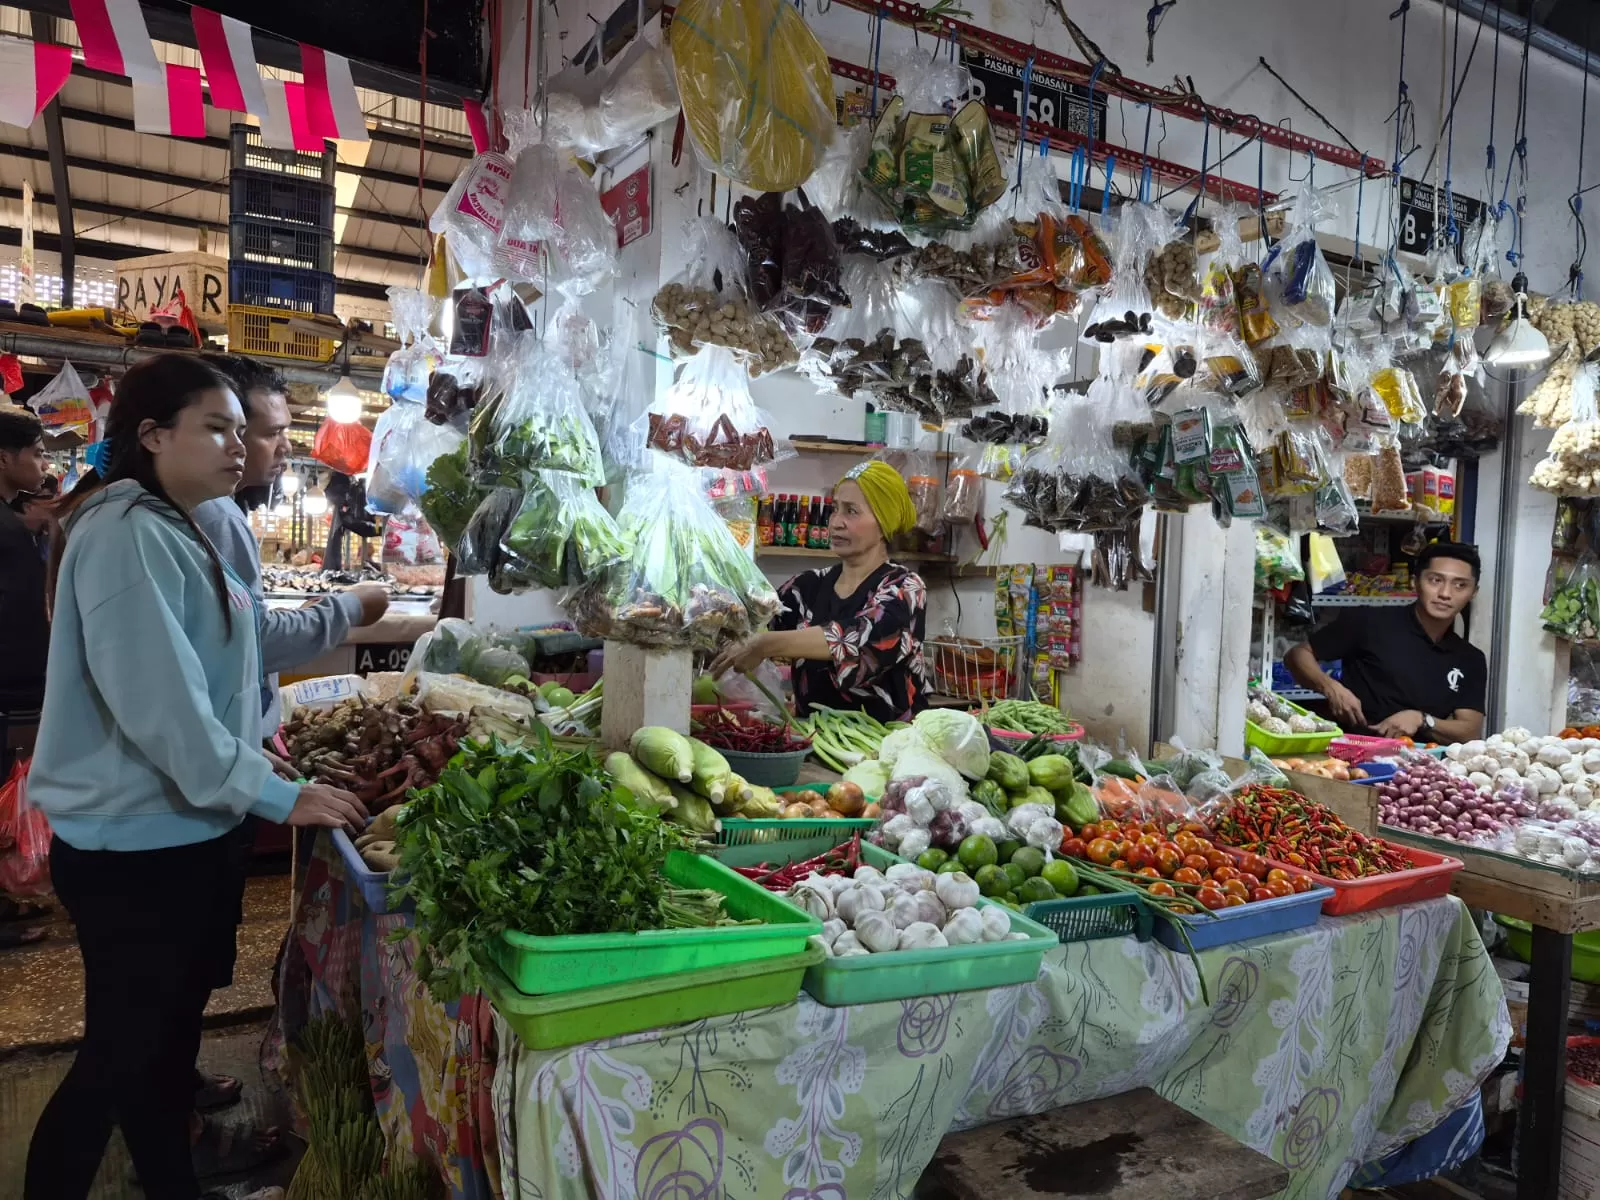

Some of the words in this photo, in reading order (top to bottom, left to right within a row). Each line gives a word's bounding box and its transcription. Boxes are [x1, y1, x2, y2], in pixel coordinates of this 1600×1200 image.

[984, 58, 1014, 76] PASAR
[1016, 67, 1068, 92] KANDASAN
[1405, 214, 1416, 245] B
[118, 274, 182, 311] RAYA
[202, 273, 222, 314] R
[360, 649, 374, 670] A
